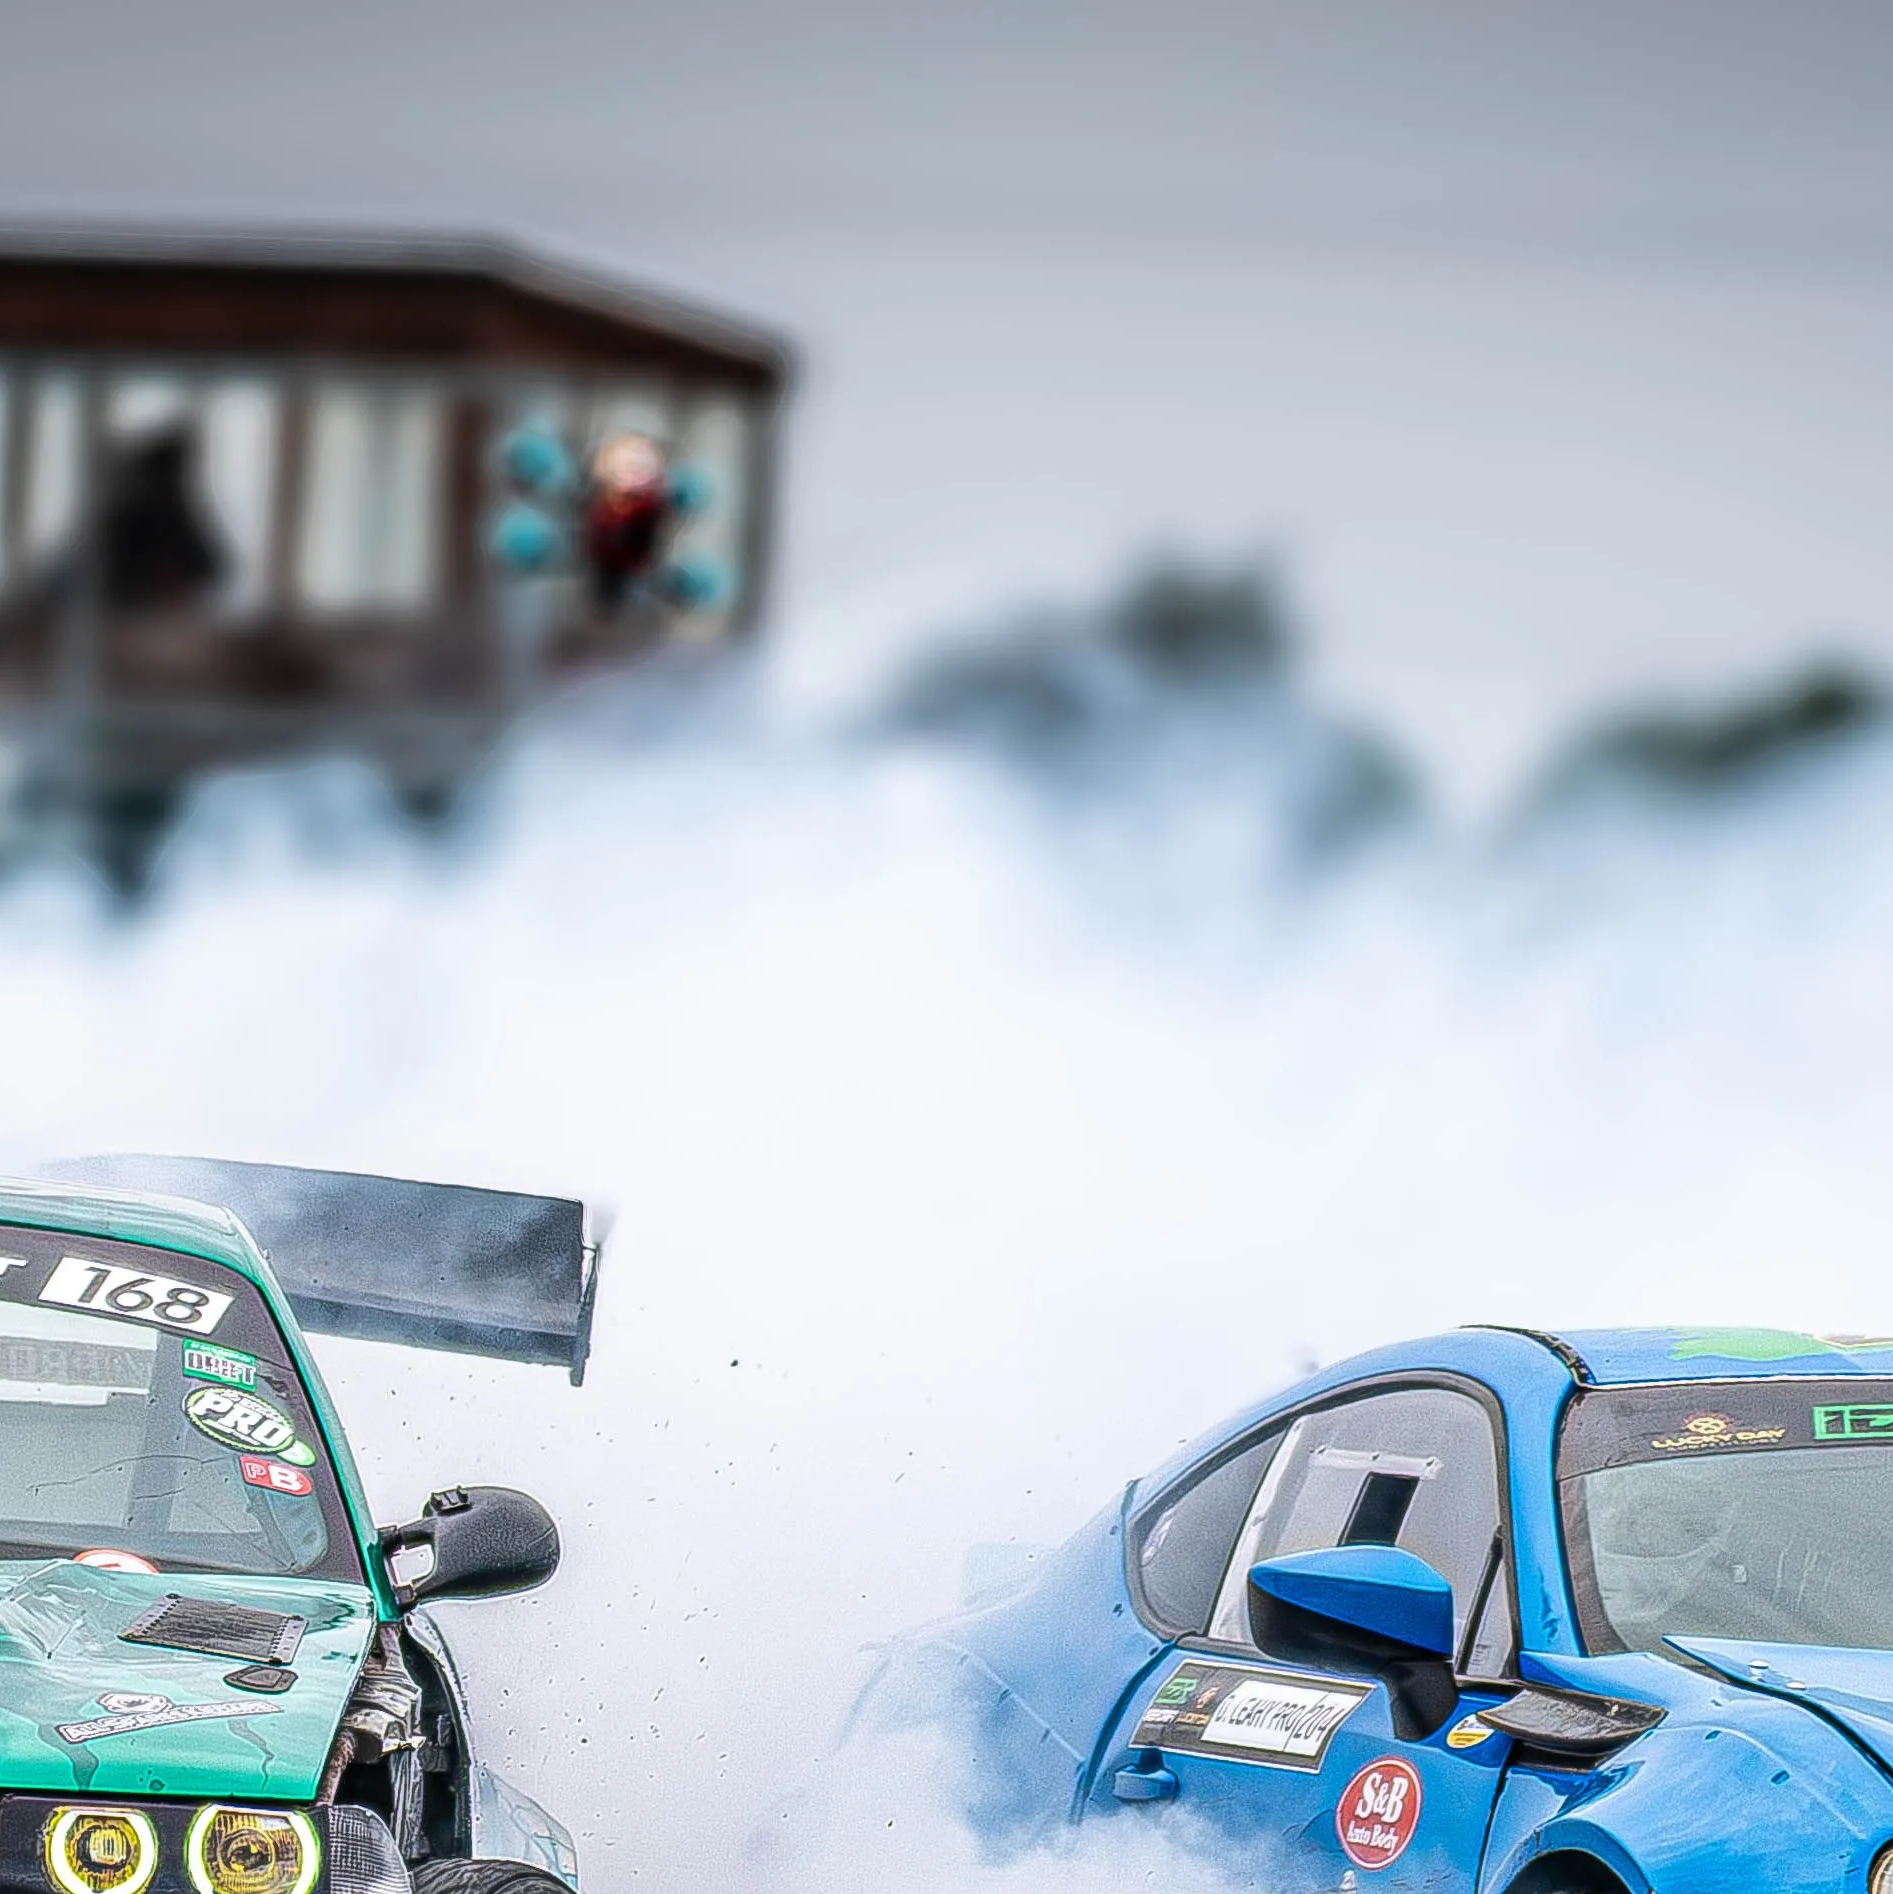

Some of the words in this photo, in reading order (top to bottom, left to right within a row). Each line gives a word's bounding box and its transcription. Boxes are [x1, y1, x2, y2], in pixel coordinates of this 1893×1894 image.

[78, 1267, 211, 1325] 168
[187, 1391, 294, 1448] PRO
[1651, 1434, 1731, 1449] LUCKY
[1735, 1428, 1787, 1440] DAY
[1228, 1696, 1277, 1727] LEAHY
[1270, 1699, 1307, 1733] PRO
[1293, 1702, 1345, 1741] 204
[1354, 1772, 1409, 1823] S&B
[1370, 1824, 1399, 1856] Body
